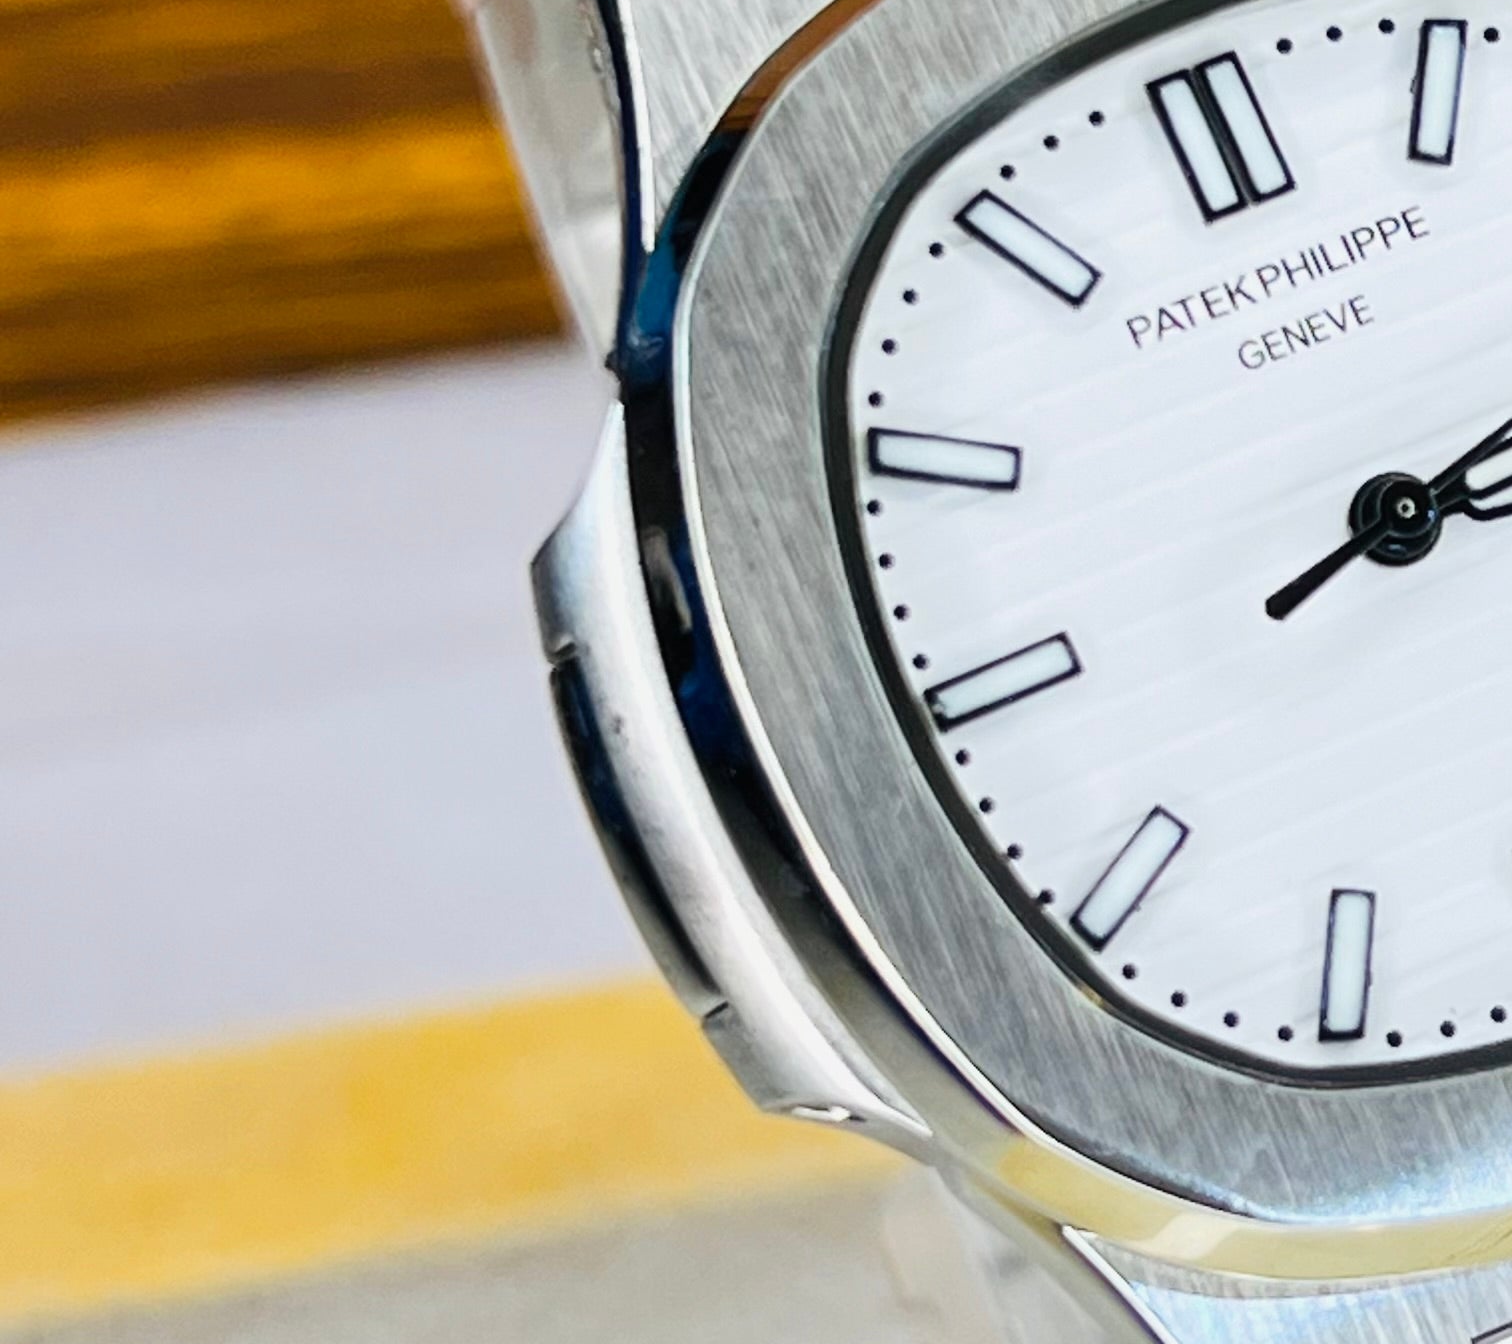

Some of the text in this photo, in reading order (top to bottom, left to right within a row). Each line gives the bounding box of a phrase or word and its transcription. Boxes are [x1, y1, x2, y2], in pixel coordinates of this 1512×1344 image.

[1126, 205, 1430, 349] PATEK PHILIPPE
[1237, 294, 1375, 370] GENEVE
